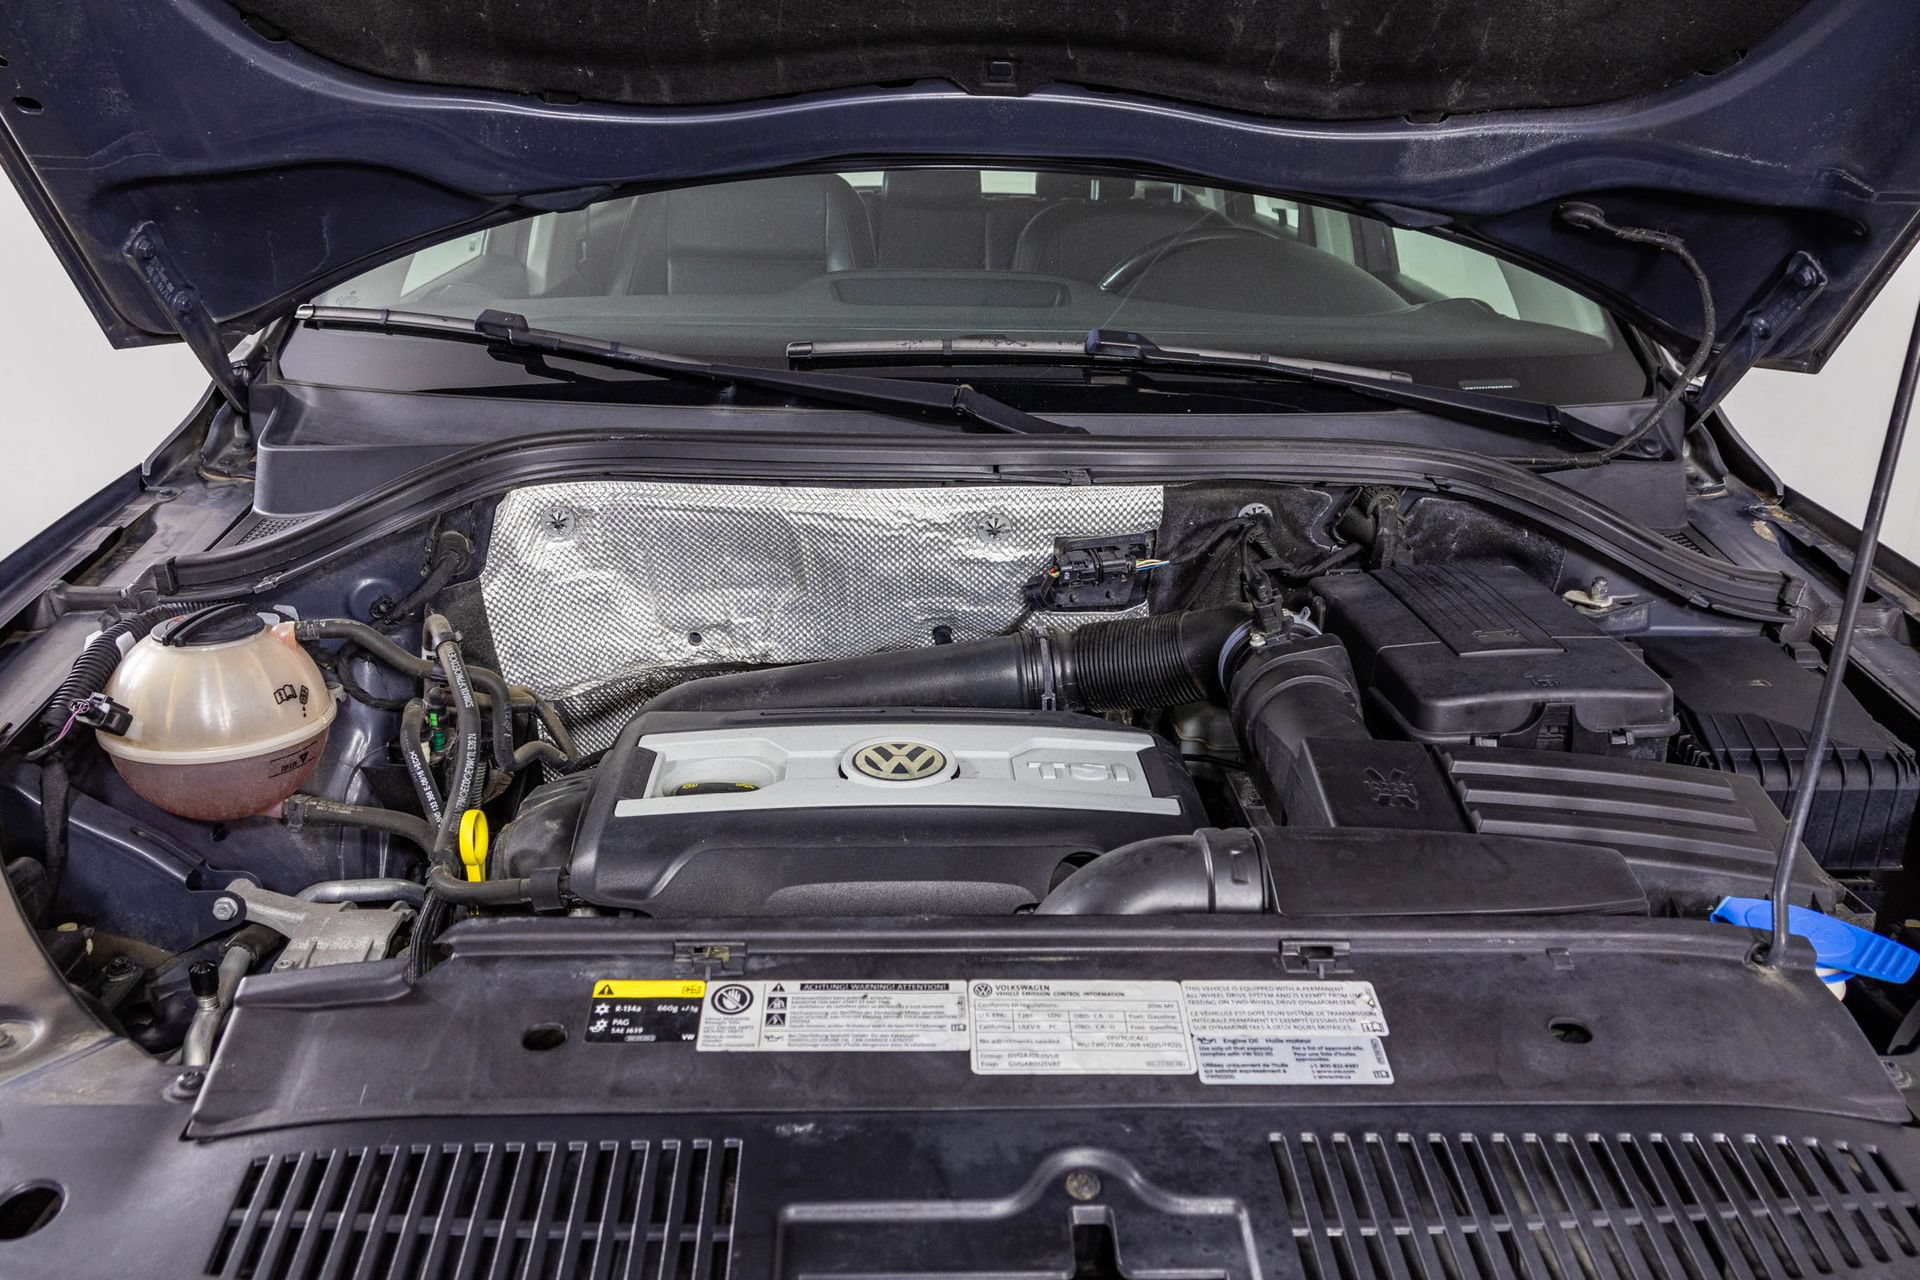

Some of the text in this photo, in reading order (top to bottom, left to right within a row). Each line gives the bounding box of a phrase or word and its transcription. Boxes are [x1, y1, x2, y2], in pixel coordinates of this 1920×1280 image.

[281, 760, 297, 772] min
[1027, 761, 1136, 783] TSI
[615, 1004, 642, 1012] R-134a
[612, 1018, 630, 1026] PAG
[681, 1033, 696, 1041] VW
